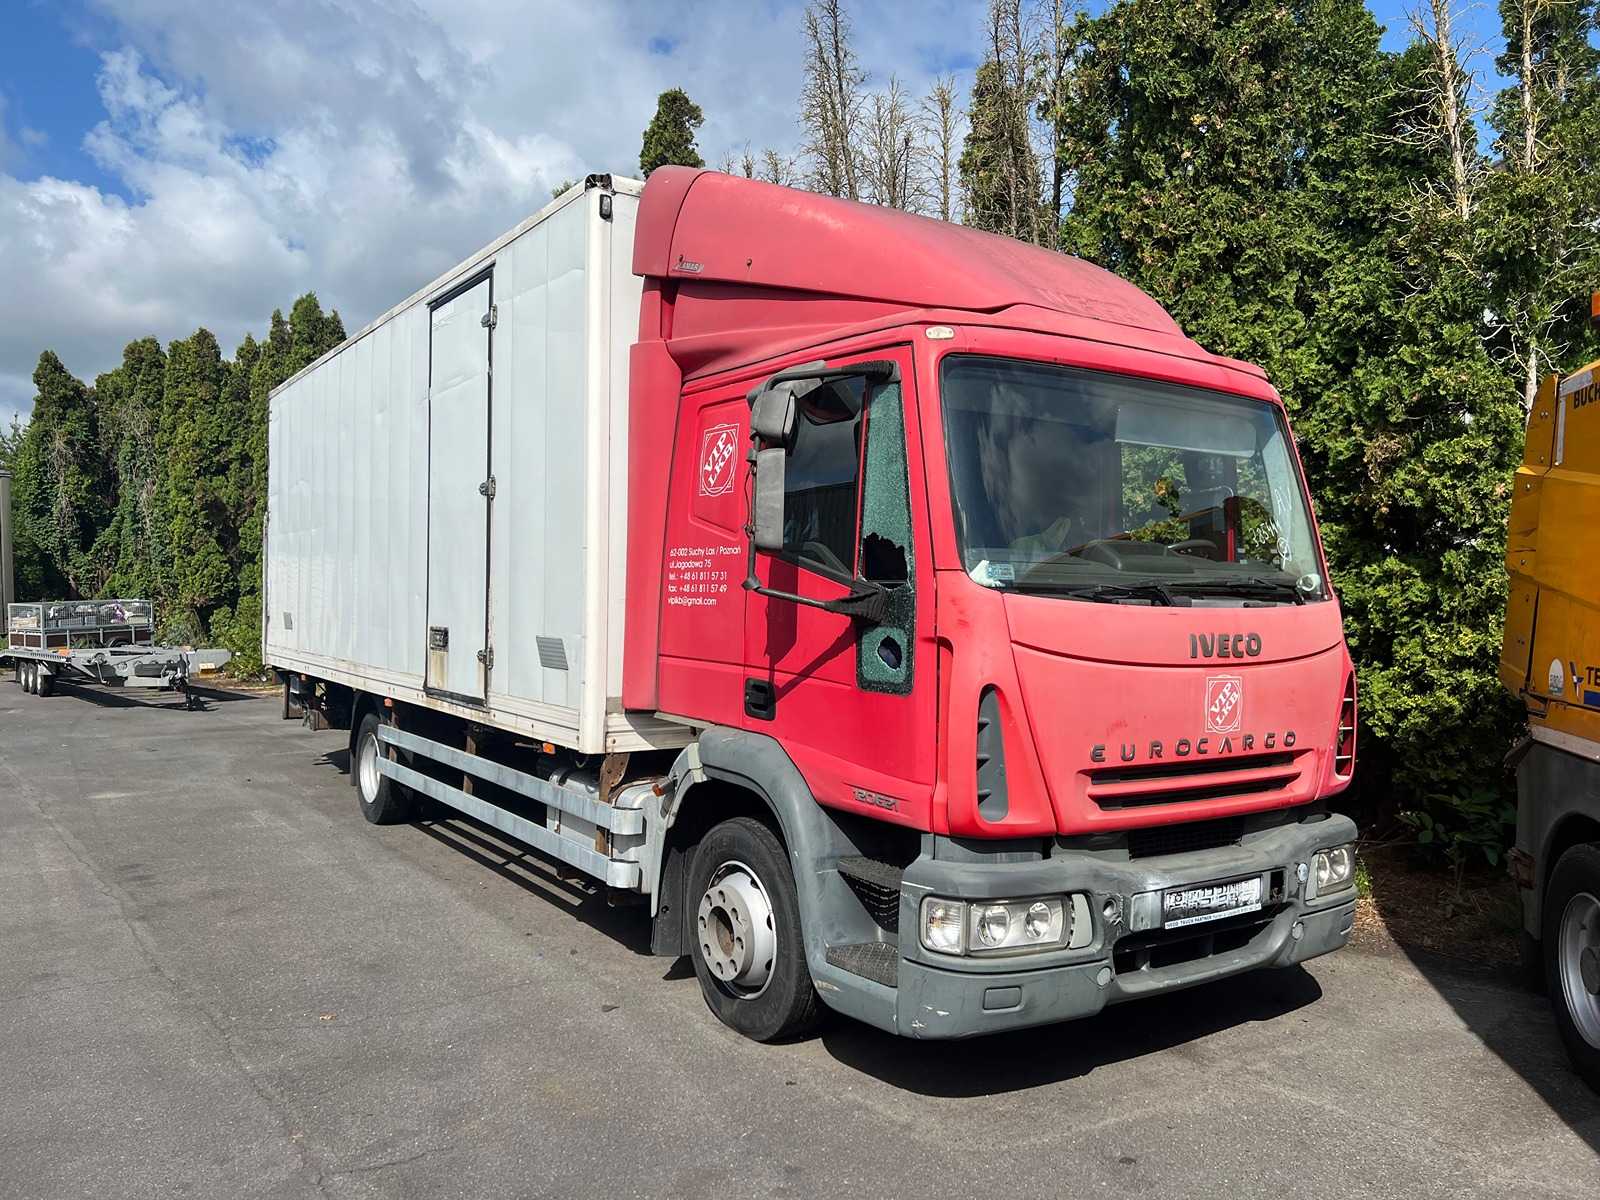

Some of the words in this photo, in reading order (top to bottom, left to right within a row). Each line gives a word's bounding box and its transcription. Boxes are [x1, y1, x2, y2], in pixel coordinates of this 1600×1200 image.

[704, 432, 727, 472] VIP
[708, 443, 733, 487] LKB
[670, 548, 687, 557] 62-002
[688, 546, 705, 557] Suchy
[705, 546, 715, 556] Las
[704, 559, 712, 568] 75
[690, 584, 698, 592] 61
[699, 584, 709, 592] 811
[710, 584, 719, 592] 57
[691, 571, 698, 580] 61
[699, 571, 710, 580] 811
[711, 571, 719, 580] 57
[720, 571, 727, 580] 31
[1190, 632, 1262, 658] IVECO
[1210, 682, 1232, 713] VIP
[1216, 691, 1239, 725] LKB
[1091, 731, 1297, 763] EUROCARGO
